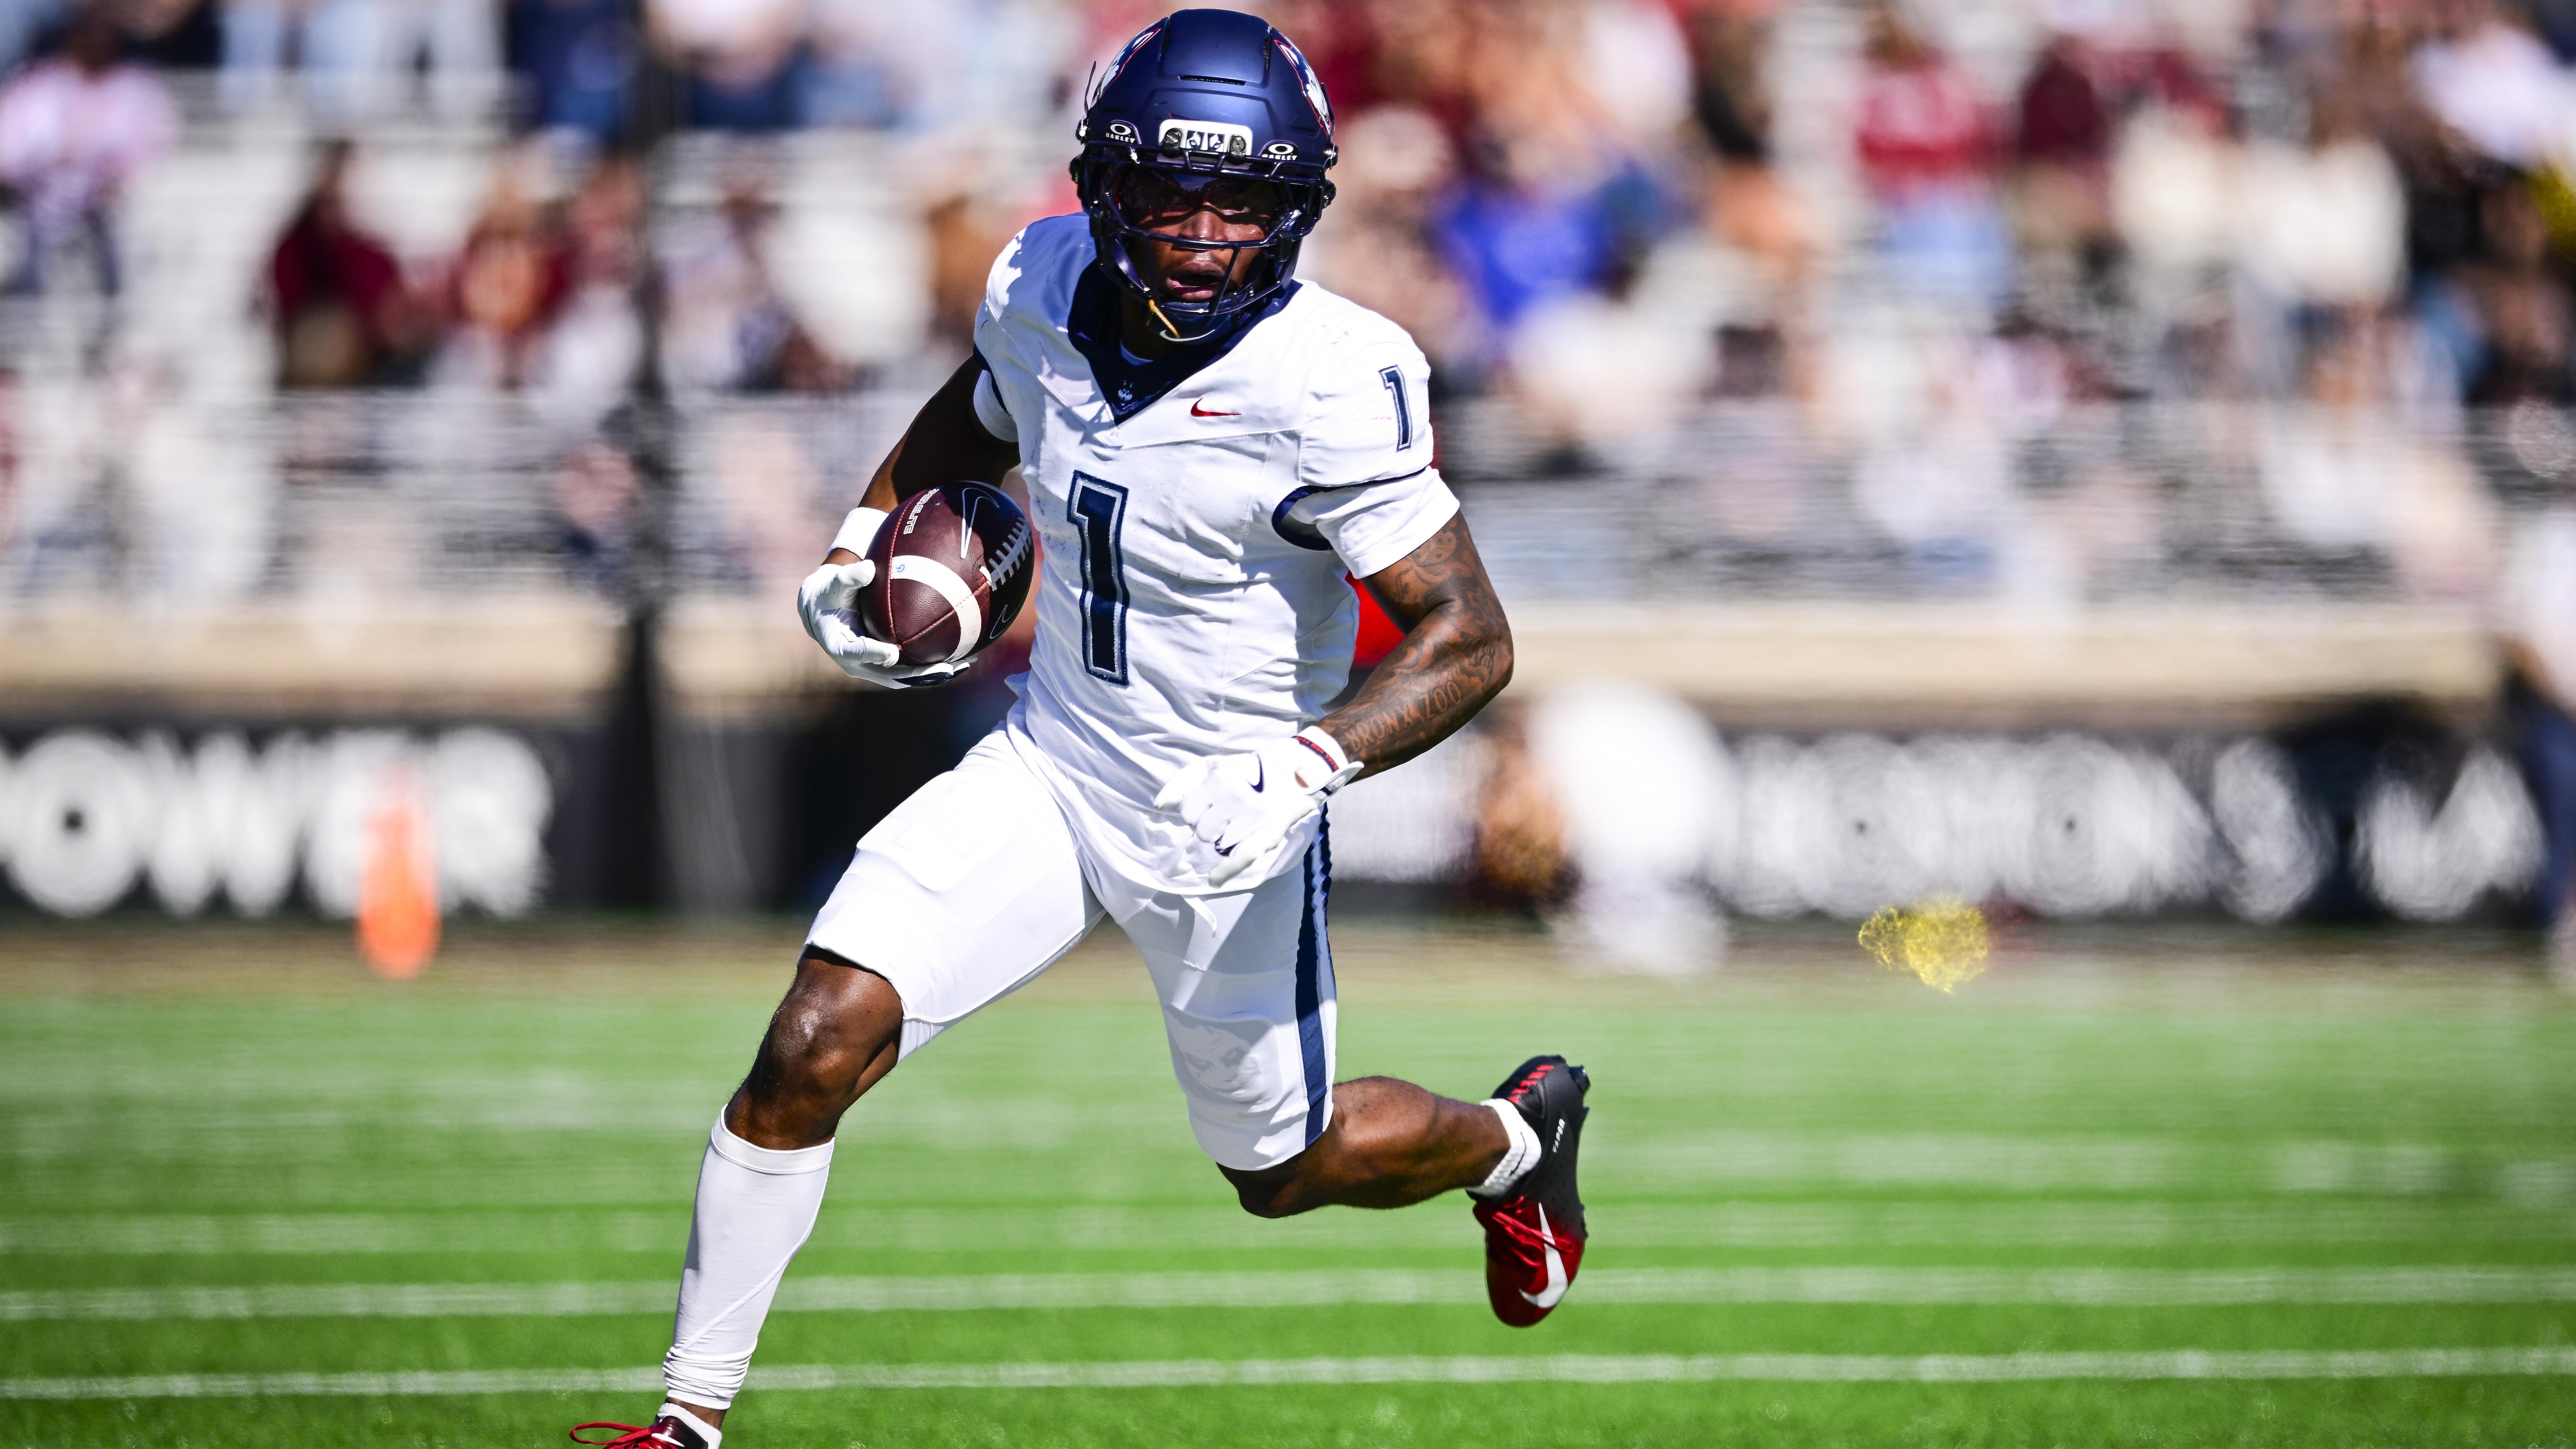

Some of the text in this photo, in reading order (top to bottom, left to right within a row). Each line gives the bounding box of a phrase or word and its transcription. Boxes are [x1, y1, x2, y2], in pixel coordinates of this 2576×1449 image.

[1106, 132, 1136, 143] OAKLEY
[1378, 364, 1413, 452] 1
[1066, 469, 1130, 686] 1
[1344, 680, 1462, 752] BRONX ZOO
